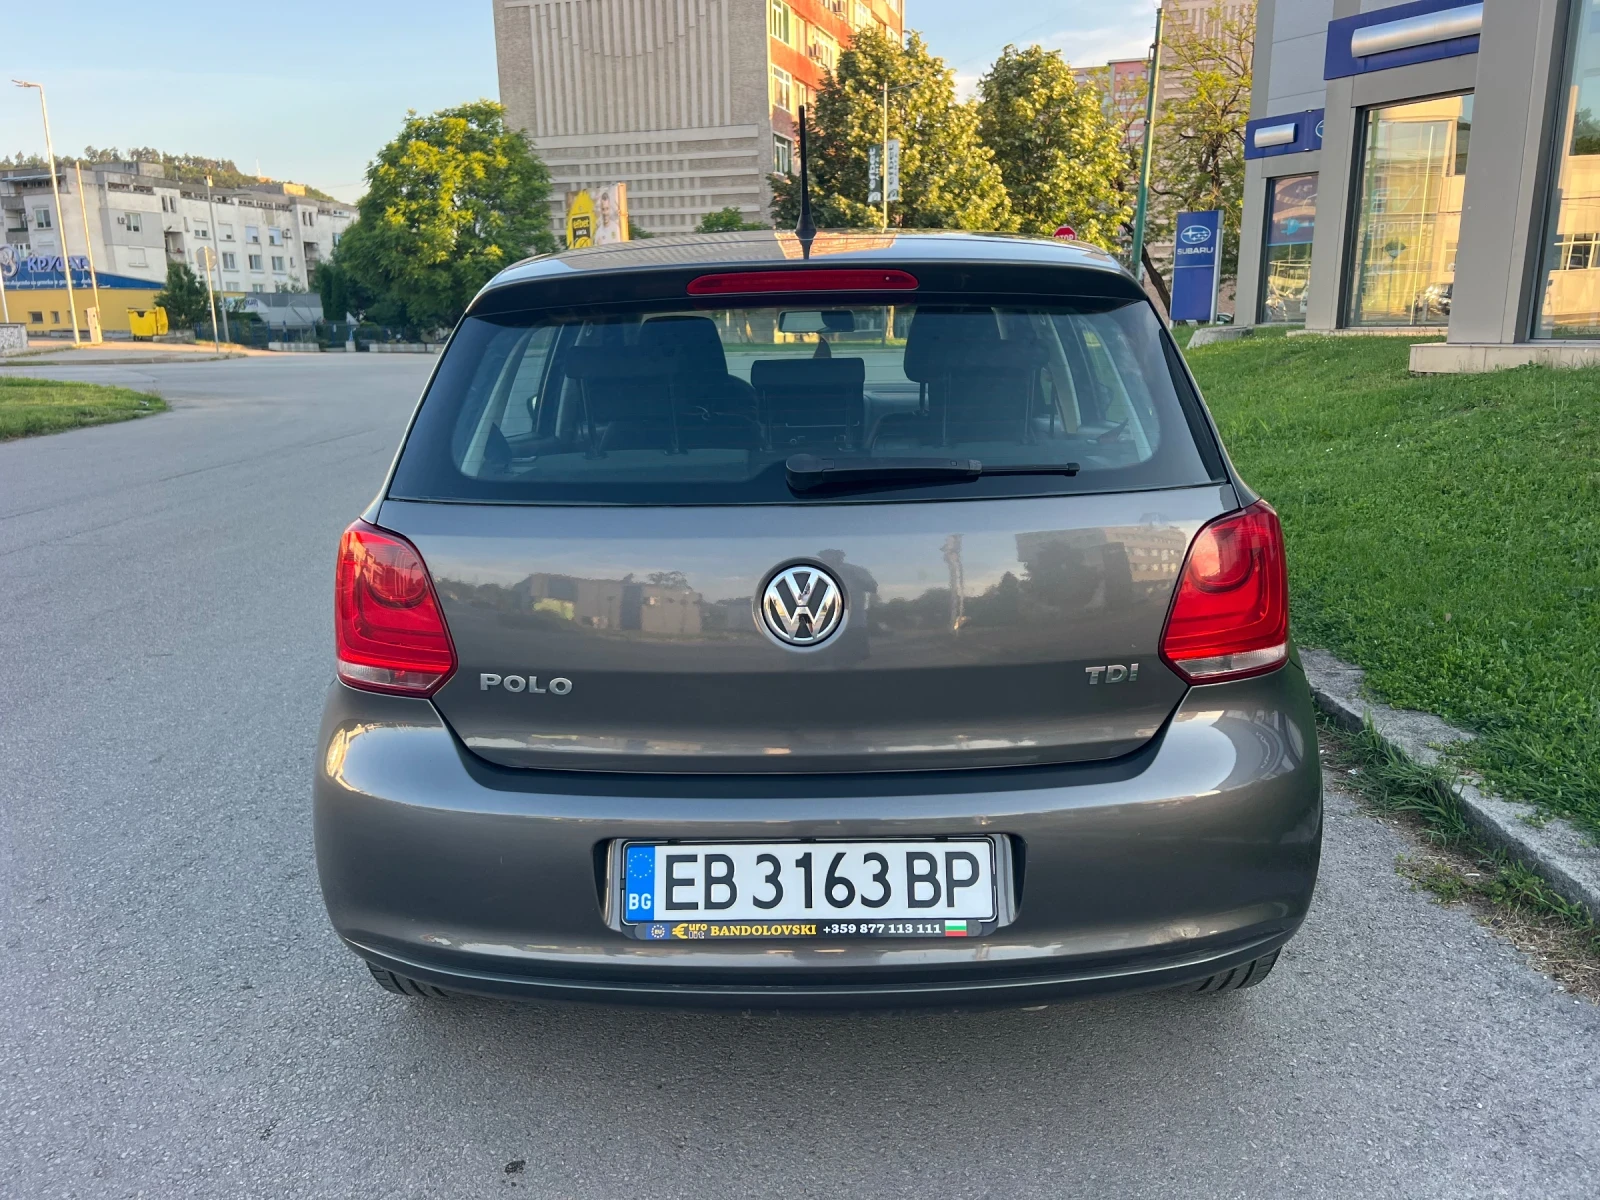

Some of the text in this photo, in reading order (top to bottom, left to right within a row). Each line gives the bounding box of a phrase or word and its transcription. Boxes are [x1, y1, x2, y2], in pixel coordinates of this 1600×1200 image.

[1177, 246, 1214, 255] SUBARU
[1085, 663, 1139, 685] TDI
[480, 673, 573, 695] POLO
[665, 851, 980, 910] EB 3163 BP
[629, 893, 652, 910] BG
[710, 924, 817, 936] BANDOLOVSKI
[822, 924, 857, 934] +359
[859, 924, 886, 934] 877
[888, 924, 914, 934] 113
[916, 924, 942, 934] 111
